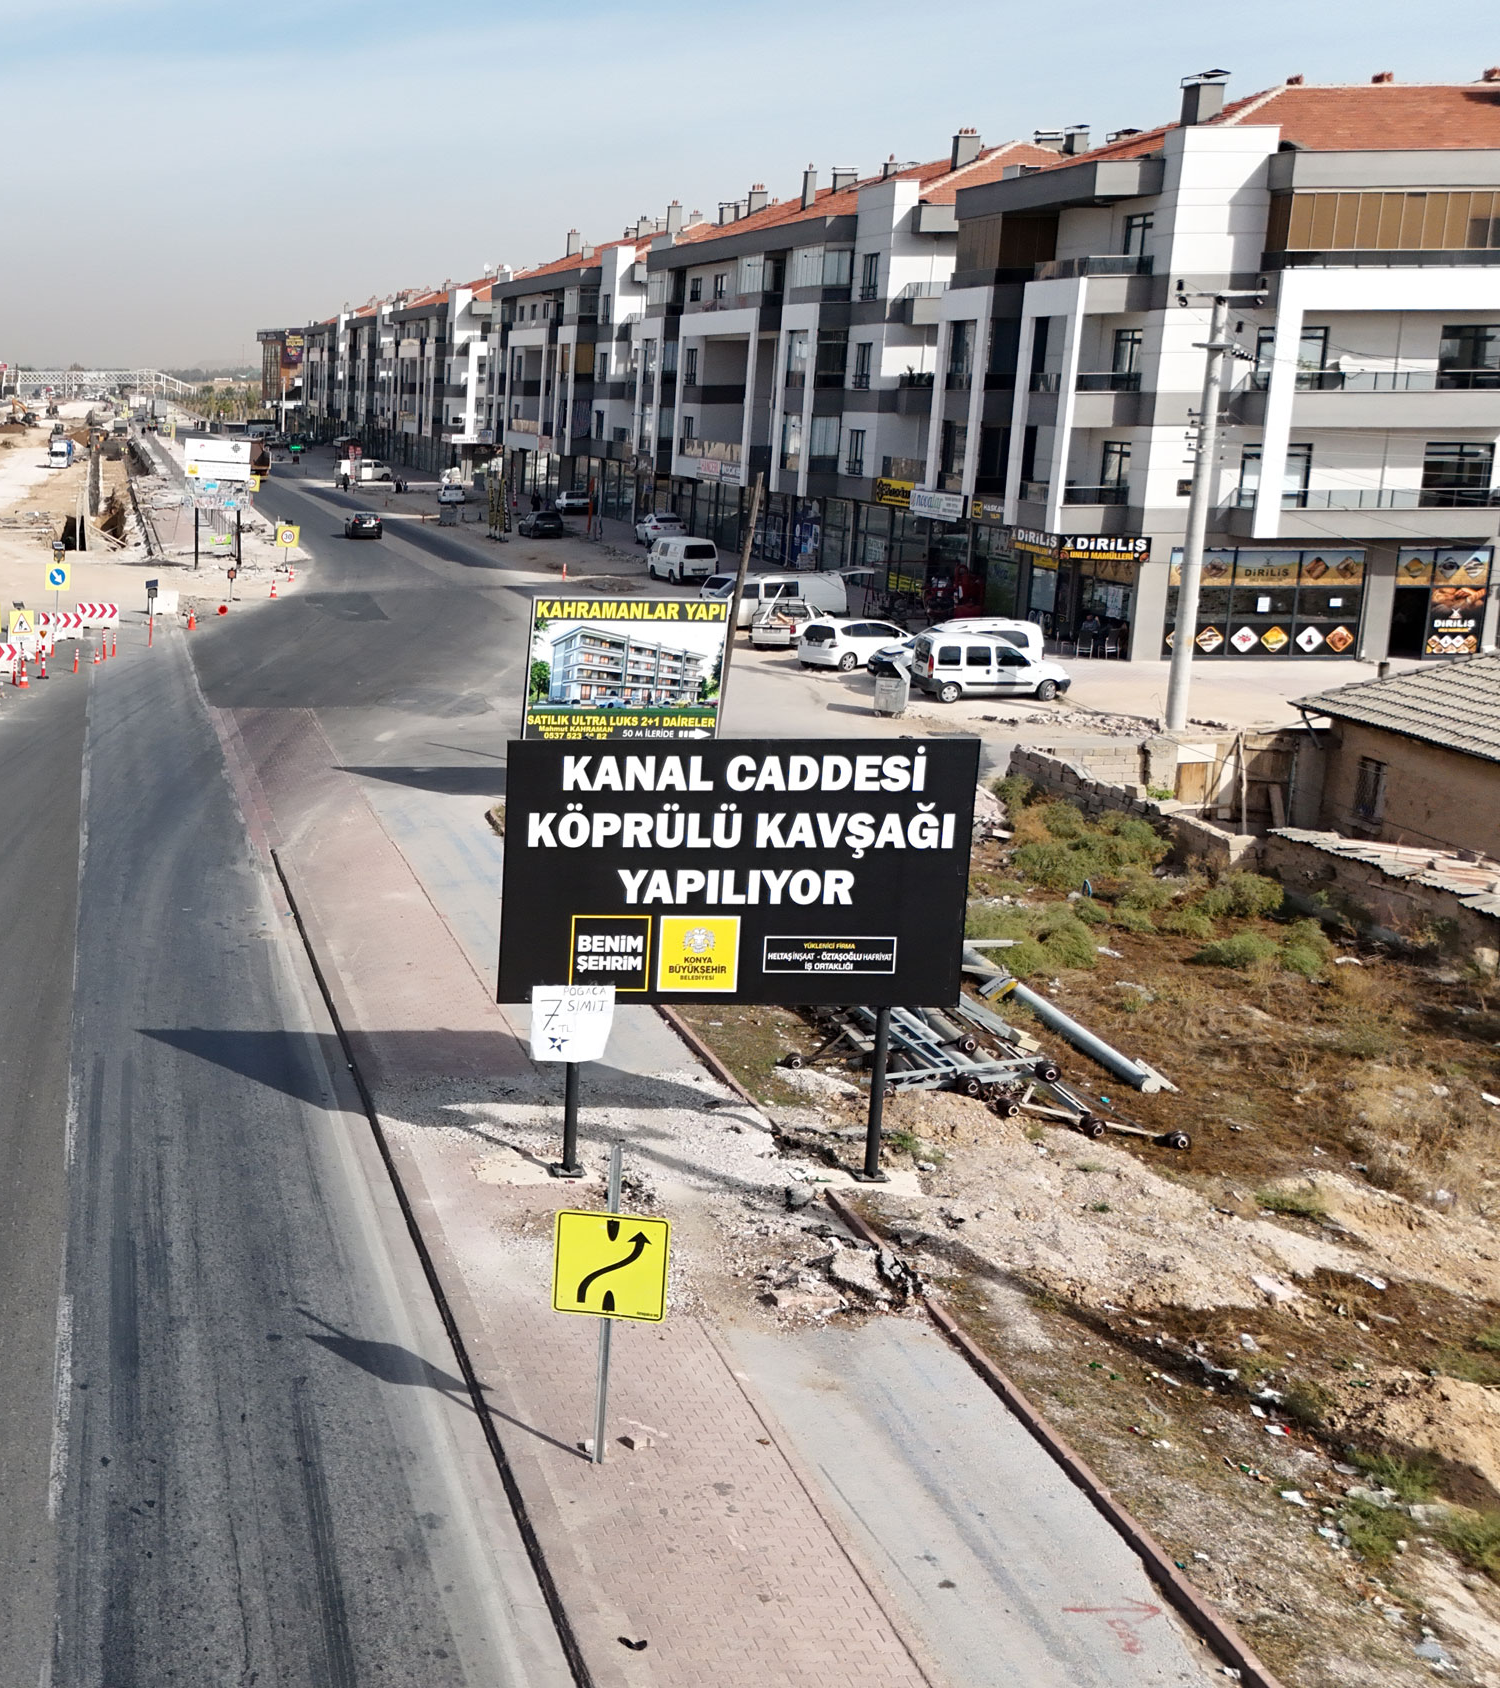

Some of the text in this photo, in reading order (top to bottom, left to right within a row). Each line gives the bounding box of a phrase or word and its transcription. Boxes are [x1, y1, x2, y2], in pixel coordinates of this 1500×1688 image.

[1069, 550, 1134, 560] UNLU MAMÜLLERİ
[536, 601, 727, 621] KAHRAMANLAR YAPI
[527, 714, 716, 728] SATILIK ULTRA LUKS 2+1 DAİRELER
[566, 732, 582, 740] 523
[622, 729, 634, 738] 50
[645, 728, 675, 738] İLERİDE
[561, 745, 927, 792] KANAL CADDESİ
[527, 802, 957, 859] KÖPRÜLÜ KAVŞAĞI
[617, 869, 855, 906] YAPILIYOR
[577, 935, 644, 953] BENİM
[803, 941, 856, 950] YÜKLENİCİ FİRMA
[683, 956, 713, 964] KONYA
[767, 952, 792, 962] HELTAŞ
[792, 951, 815, 962] İNŞAAT
[821, 951, 862, 962] ÖZTAŞOĞLU
[862, 951, 893, 961] HAFRİYAT
[576, 955, 643, 973] ŞEHRİM
[668, 964, 727, 974] BÜYÜKŞEHİR
[804, 961, 854, 971] İŞ ORTAKLIĞI
[558, 1024, 573, 1033] TL
